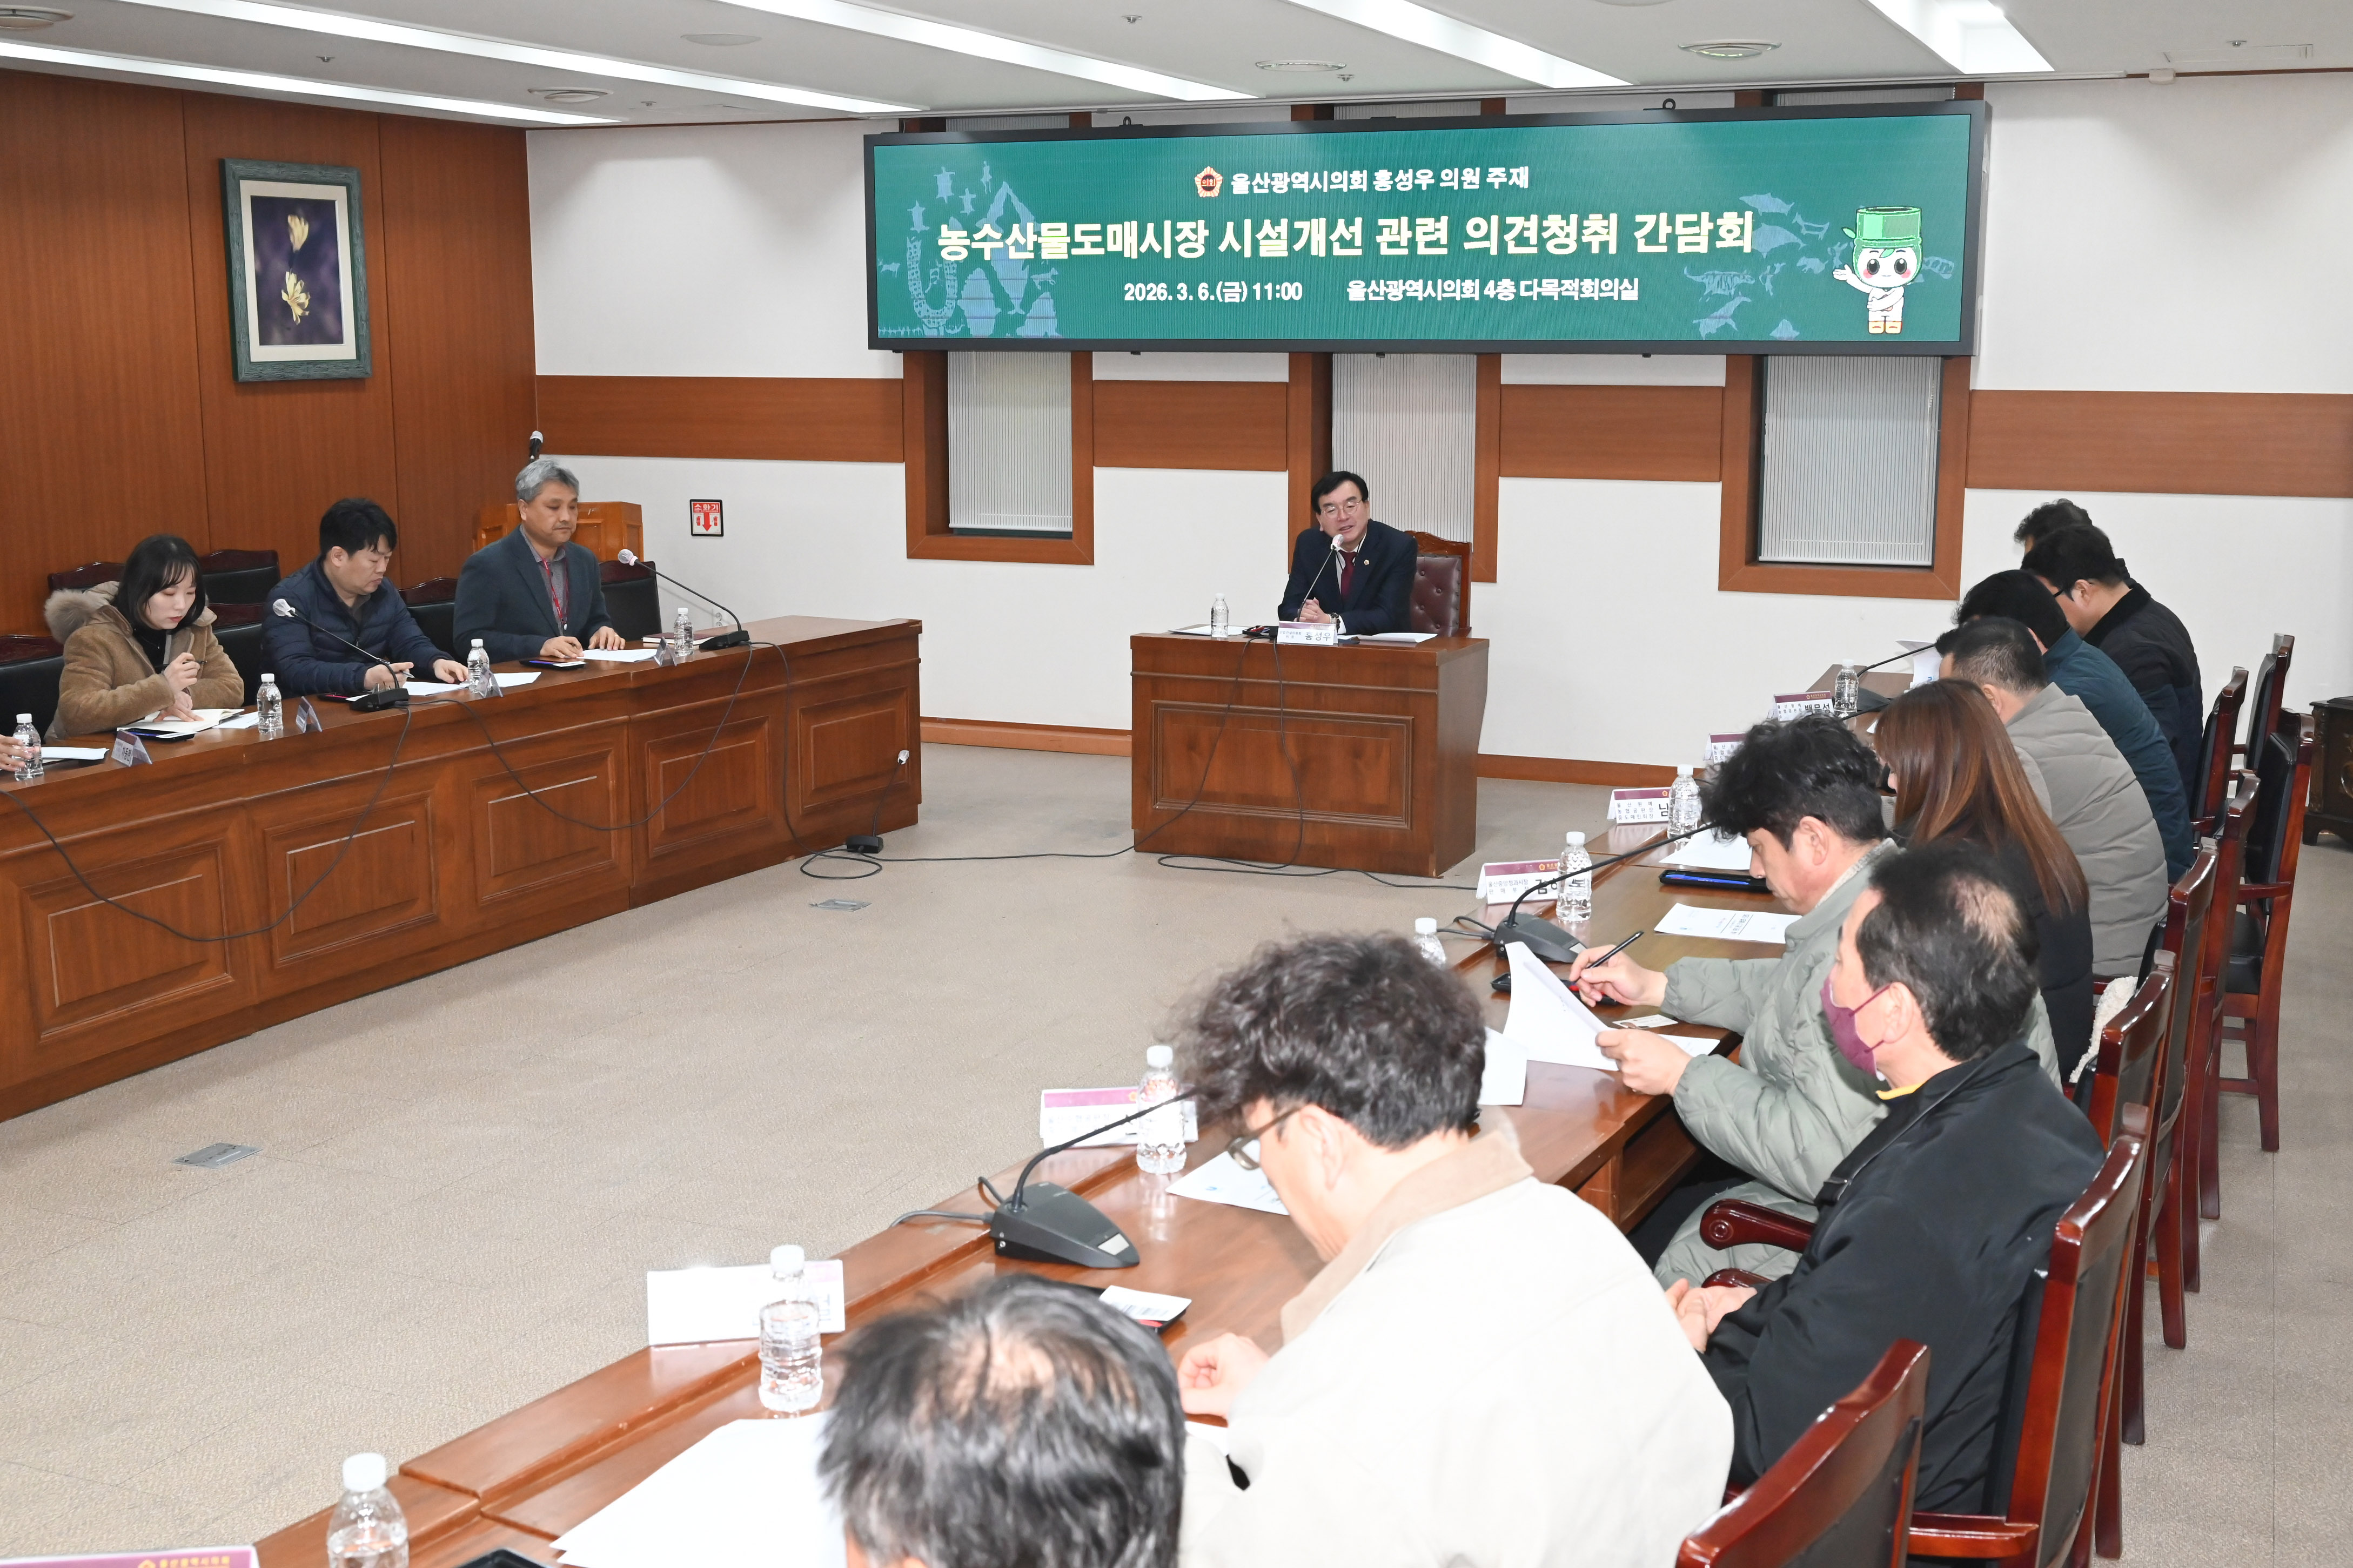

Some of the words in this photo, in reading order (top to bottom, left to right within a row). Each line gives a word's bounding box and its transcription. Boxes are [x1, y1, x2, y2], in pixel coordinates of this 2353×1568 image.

[1231, 170, 1367, 194] 울산광역시의회
[1373, 169, 1435, 191] 홍성우
[1439, 167, 1480, 190] 의원
[1486, 166, 1529, 189] 주재
[938, 220, 1209, 261] 농수산물도매시장
[1218, 217, 1363, 258] 시설개선
[1376, 216, 1449, 255] 관련
[1463, 213, 1618, 255] 의견청취
[1633, 211, 1754, 253] 간담회
[1124, 282, 1173, 301] 2026.
[1177, 282, 1194, 301] 3.
[1252, 281, 1303, 301] 11:00
[1346, 279, 1479, 301] 울산광역시의회
[1484, 279, 1517, 301] 4층
[1520, 278, 1639, 301] 다목적회의실
[1305, 631, 1331, 641] 홍성우
